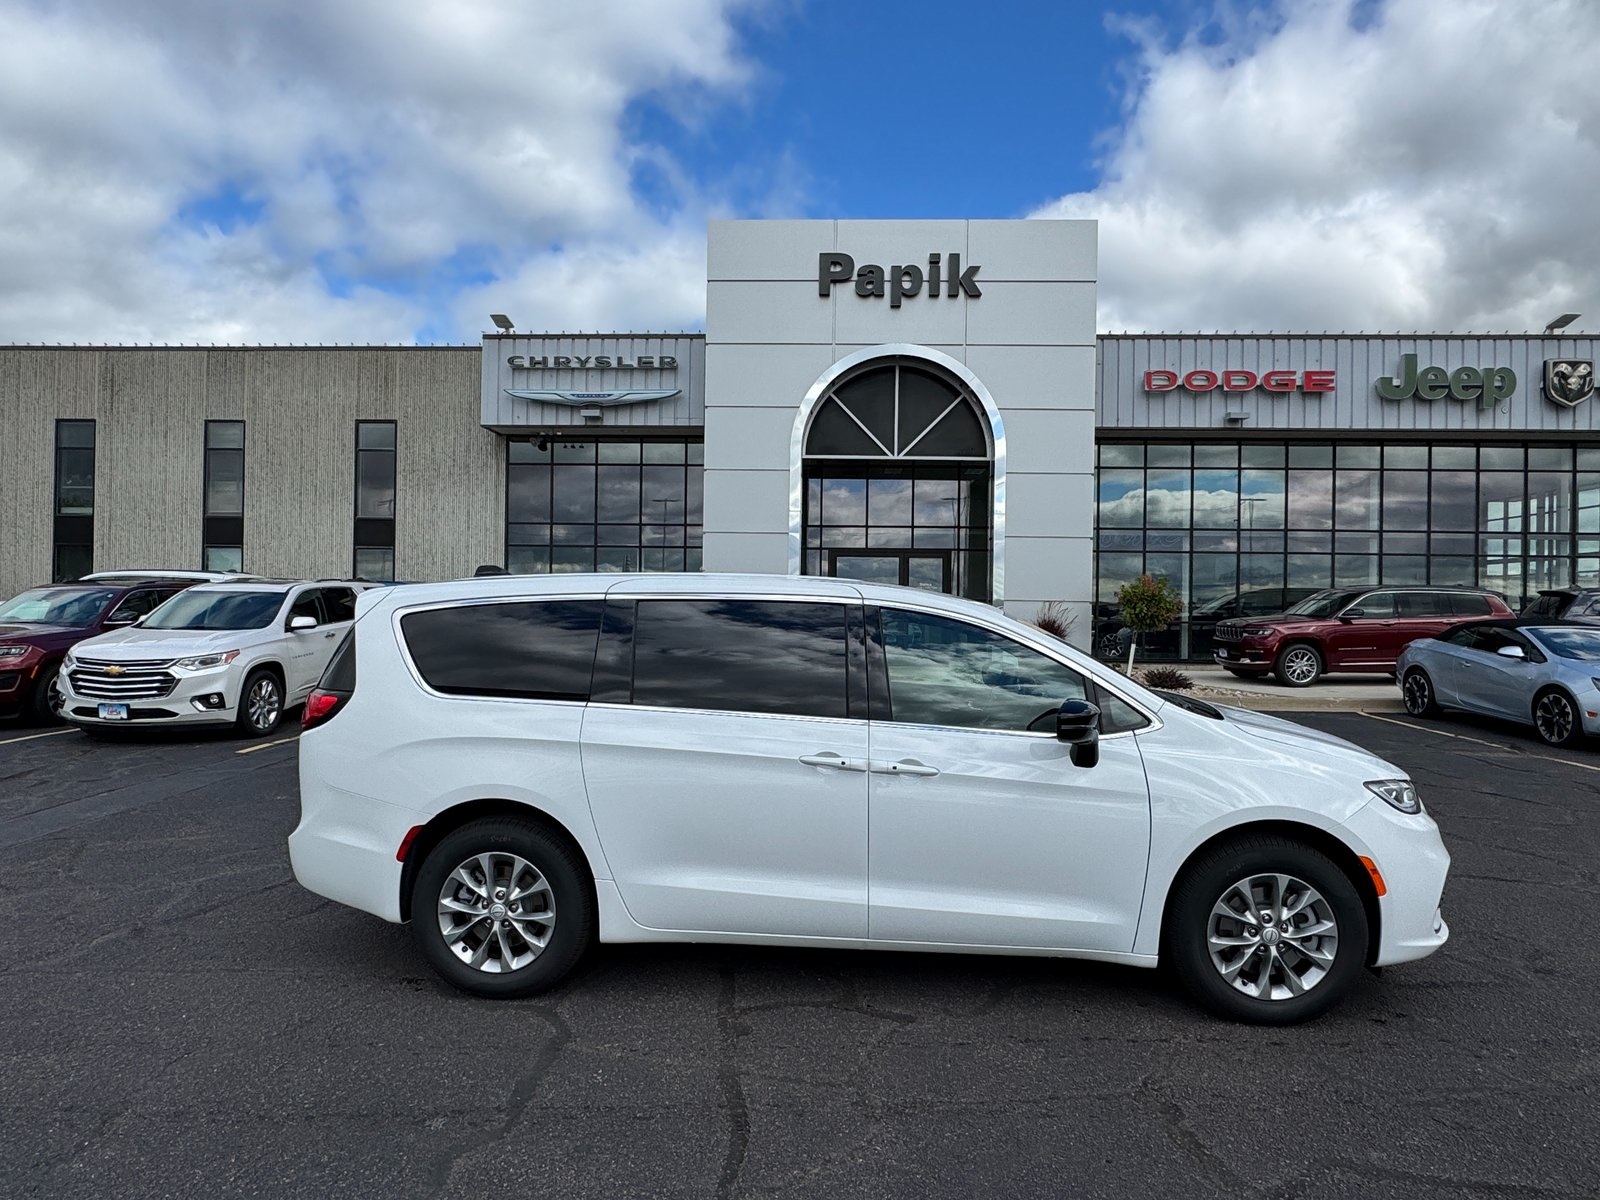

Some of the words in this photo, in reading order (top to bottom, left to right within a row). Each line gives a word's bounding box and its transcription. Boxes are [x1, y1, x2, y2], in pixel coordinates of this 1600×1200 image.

[819, 253, 982, 308] Papik
[507, 355, 678, 369] CHRYSLER
[1144, 370, 1336, 392] DODGE
[1376, 353, 1517, 409] Jeep
